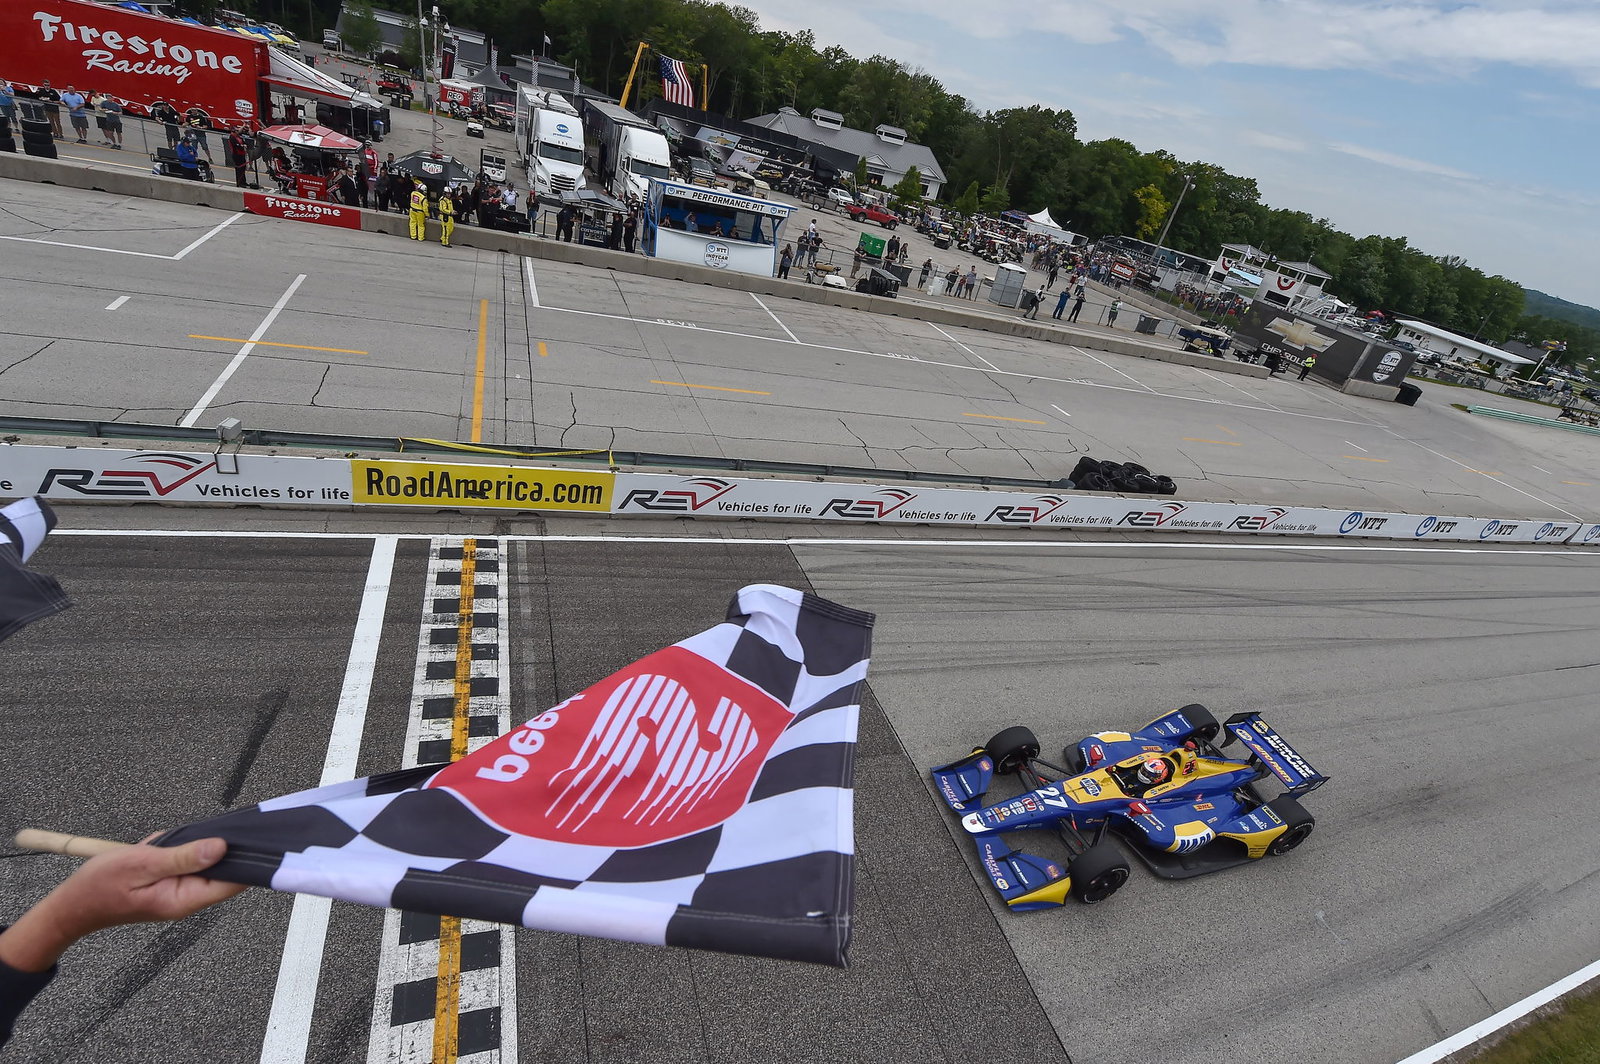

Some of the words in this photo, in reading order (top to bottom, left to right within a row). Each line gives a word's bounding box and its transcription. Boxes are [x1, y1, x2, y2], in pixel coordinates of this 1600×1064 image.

[33, 11, 243, 74] Firestone
[82, 50, 192, 85] Racing
[737, 143, 770, 156] CHEVROLET
[265, 197, 341, 217] Firestone
[692, 192, 751, 209] PERFORMANCE
[752, 203, 765, 212] PIT
[283, 210, 321, 220] Racing
[37, 459, 217, 496] REV
[366, 466, 603, 506] RoadAmerica.com
[196, 484, 280, 499] Vehicles
[288, 485, 315, 500] for
[321, 486, 350, 501] life
[617, 483, 737, 512] REV
[717, 501, 769, 514] Vehicles
[773, 502, 791, 515] for
[793, 503, 812, 515] life
[818, 494, 918, 519] REV
[899, 509, 942, 521] Vehicles
[944, 511, 959, 522] for
[961, 511, 976, 522] life
[984, 500, 1068, 523] REV
[1116, 506, 1189, 527] REV
[1050, 514, 1084, 525] Vehicles
[1086, 515, 1100, 525] for
[1100, 516, 1113, 526] life
[1170, 518, 1200, 528] Vehicles
[1201, 519, 1211, 528] for
[1212, 519, 1223, 529] life
[1226, 510, 1289, 531] REV
[1272, 522, 1297, 531] Vehicles
[1298, 523, 1307, 532] for
[1307, 523, 1318, 532] life
[1358, 516, 1388, 532] NTT
[1432, 521, 1457, 534] NTT
[1495, 524, 1518, 536] NTT
[1546, 526, 1567, 538] NTT
[1035, 786, 1069, 808] 27
[1123, 811, 1150, 833] Firestone
